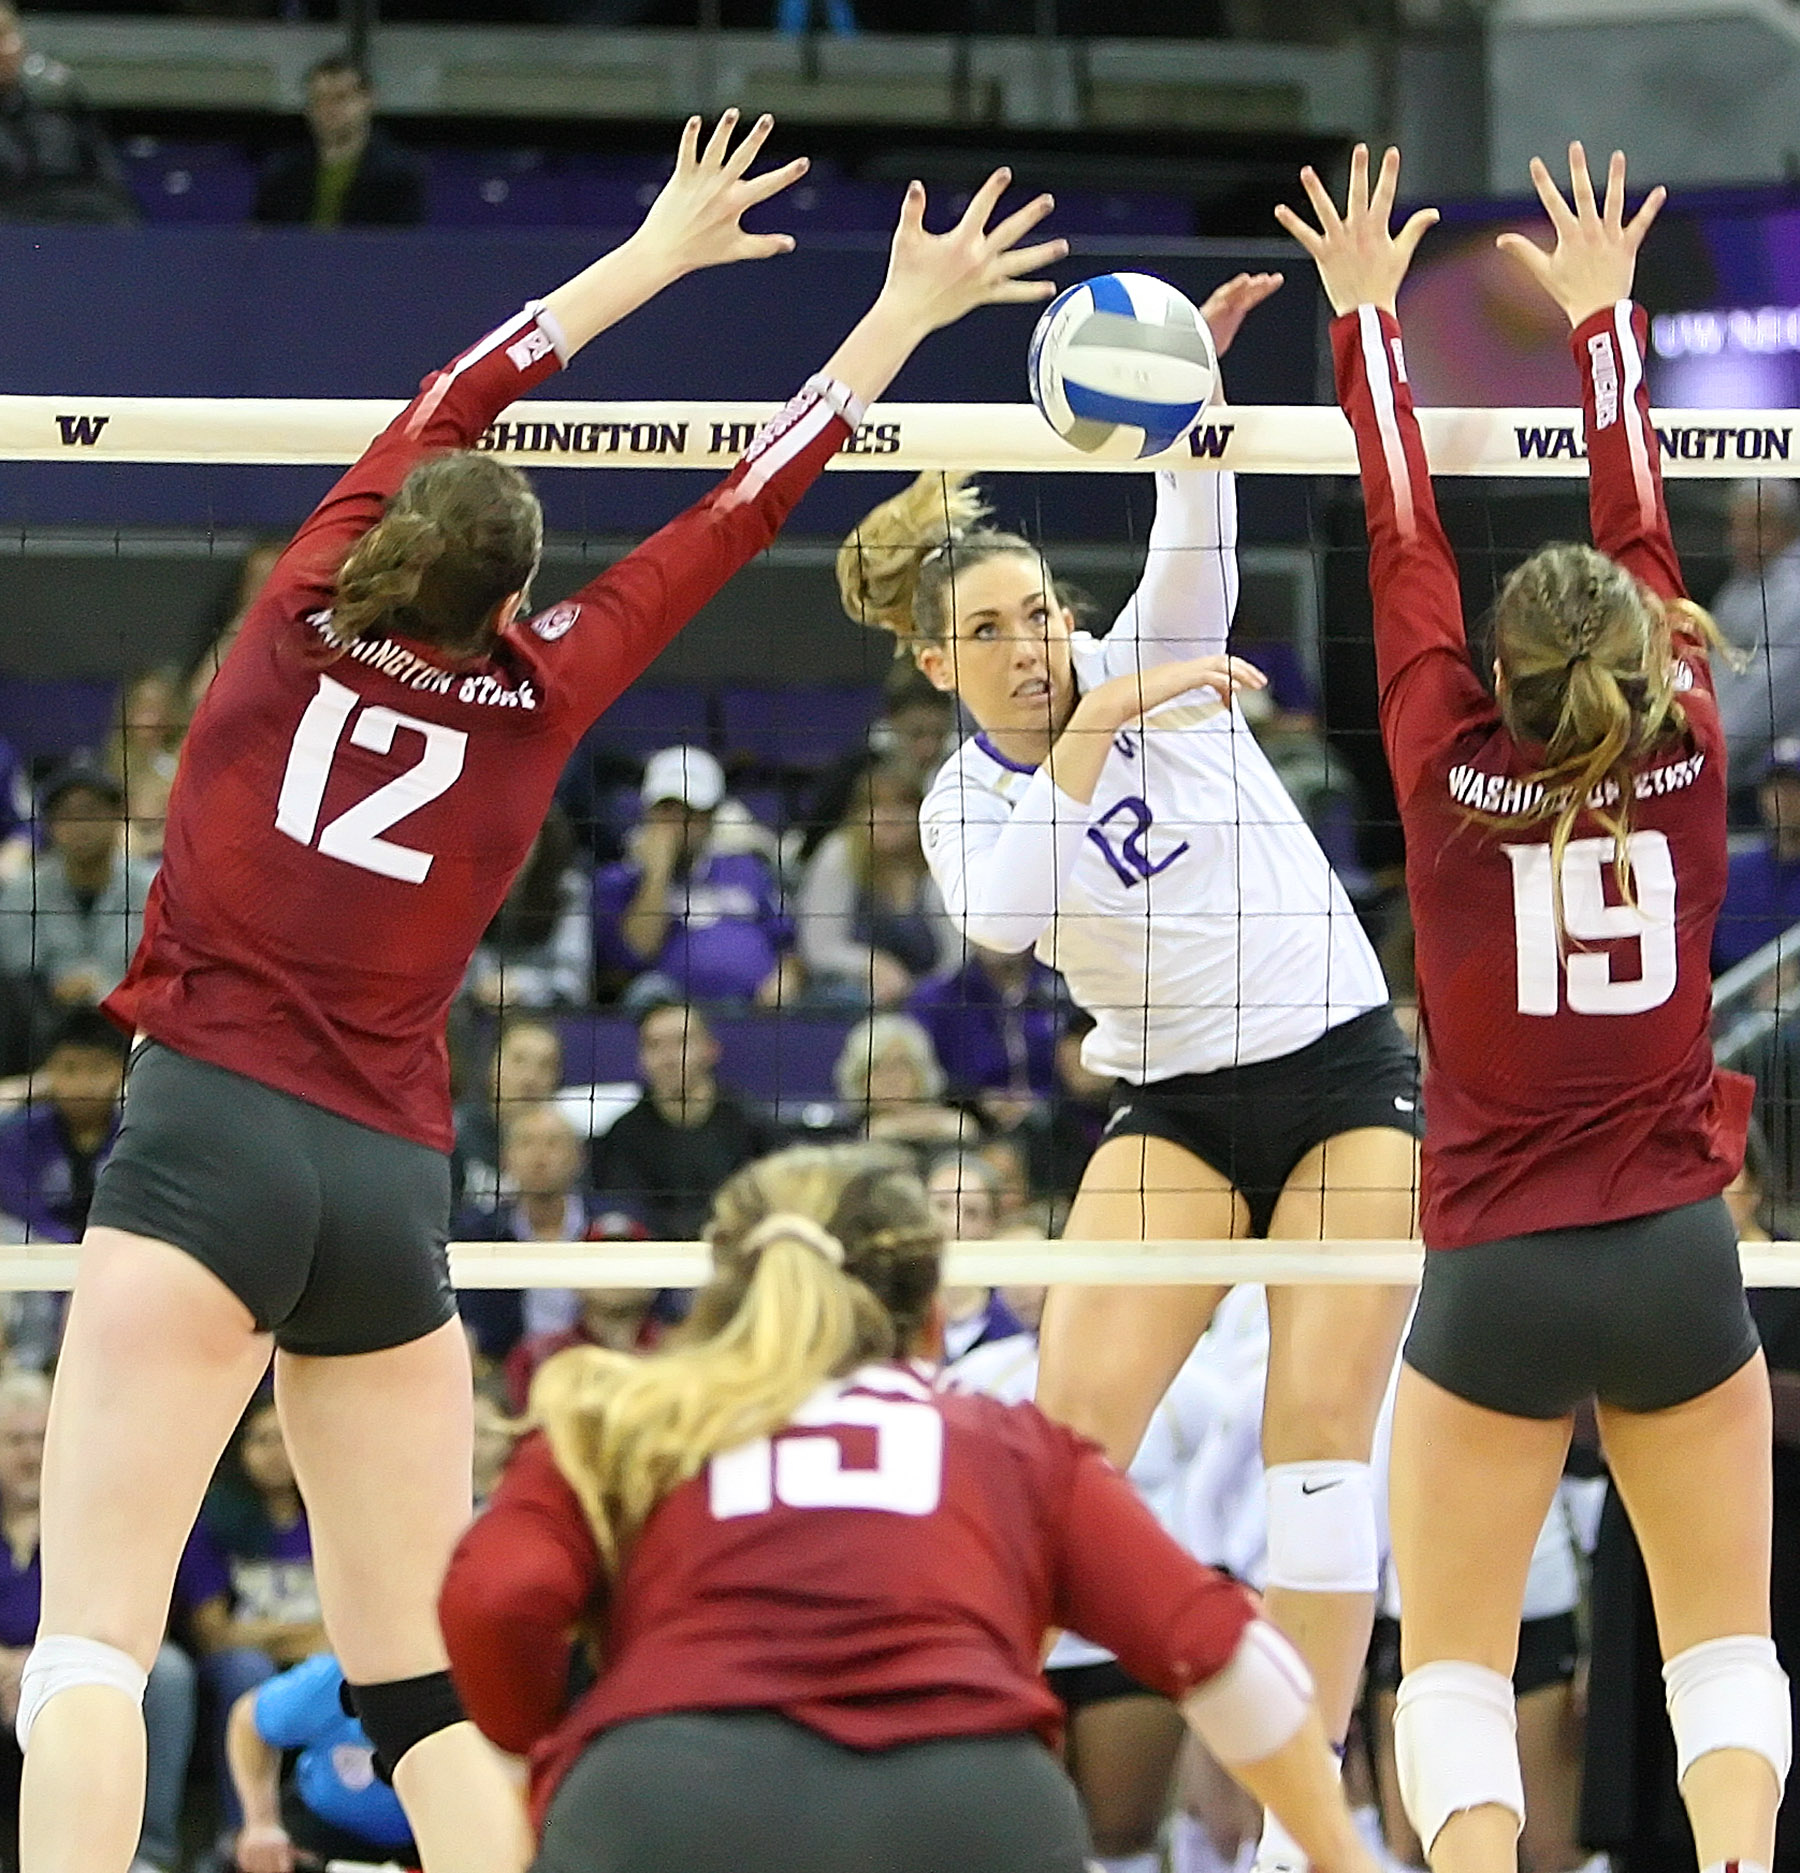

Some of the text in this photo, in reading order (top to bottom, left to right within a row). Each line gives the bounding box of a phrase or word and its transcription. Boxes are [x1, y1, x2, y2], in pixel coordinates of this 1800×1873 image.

[55, 415, 109, 446] W
[1188, 425, 1235, 458] W
[1514, 426, 1793, 459] WANGTON
[274, 672, 469, 885] 12
[1087, 796, 1190, 889] 12
[1500, 829, 1678, 1016] 19
